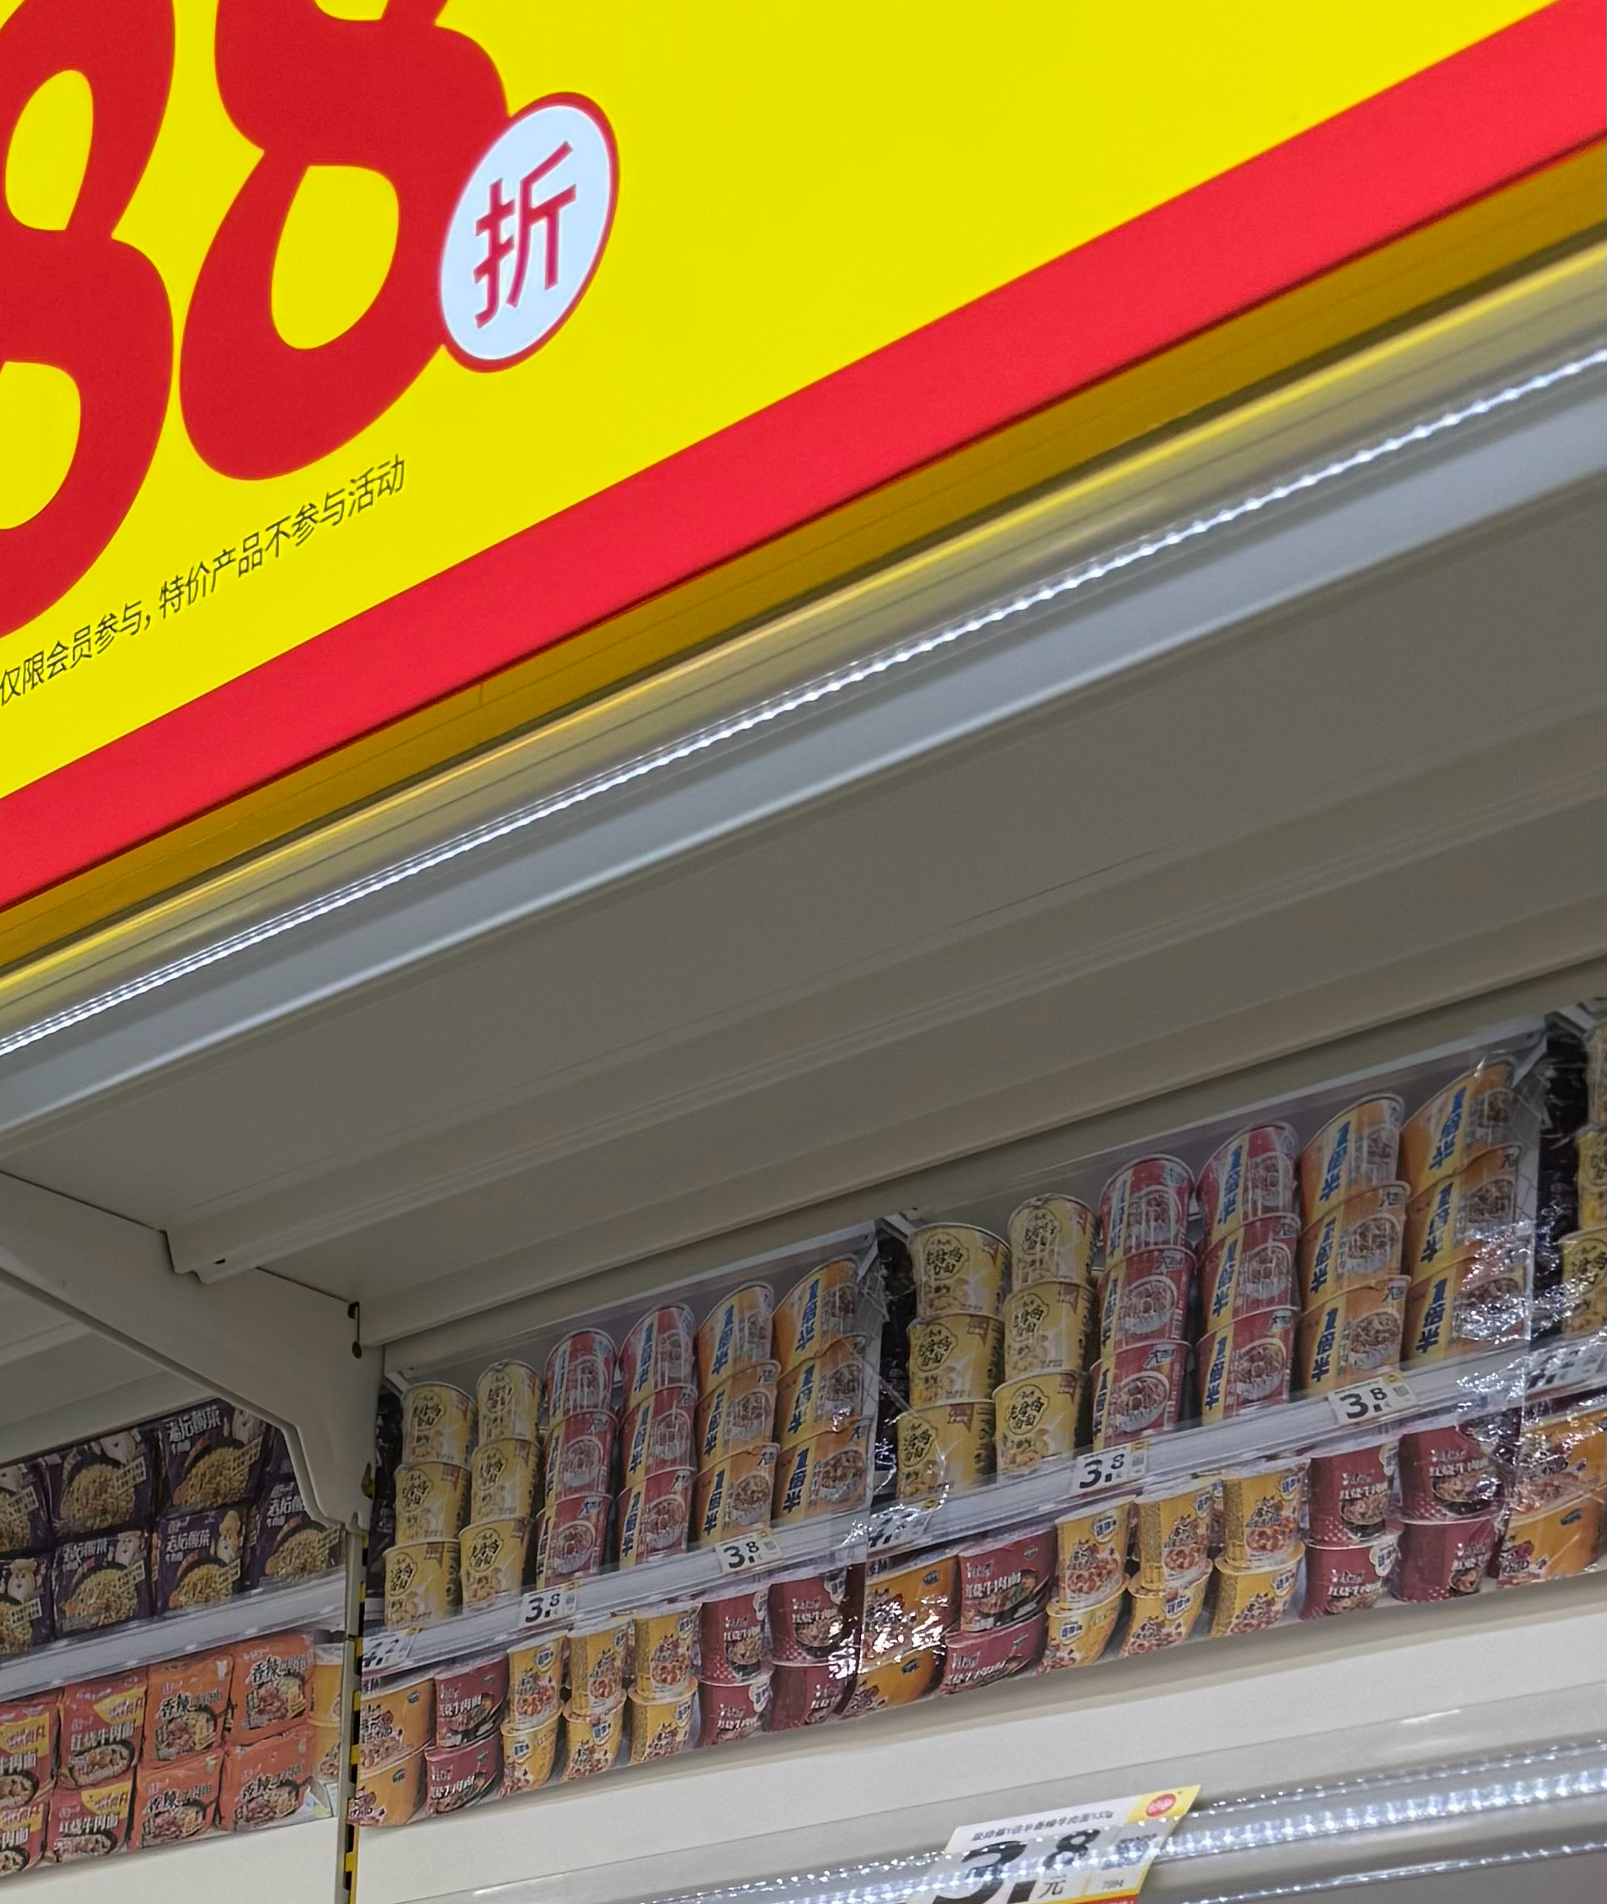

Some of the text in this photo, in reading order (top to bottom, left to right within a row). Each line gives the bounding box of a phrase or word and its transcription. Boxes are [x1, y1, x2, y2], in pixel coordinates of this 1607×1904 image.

[474, 142, 578, 328] 折
[1347, 1387, 1387, 1419] 3.8
[1080, 1454, 1124, 1488] 3.8
[724, 1541, 760, 1568] 3.8
[525, 1593, 560, 1623] 3.8
[1037, 1878, 1066, 1900] 元
